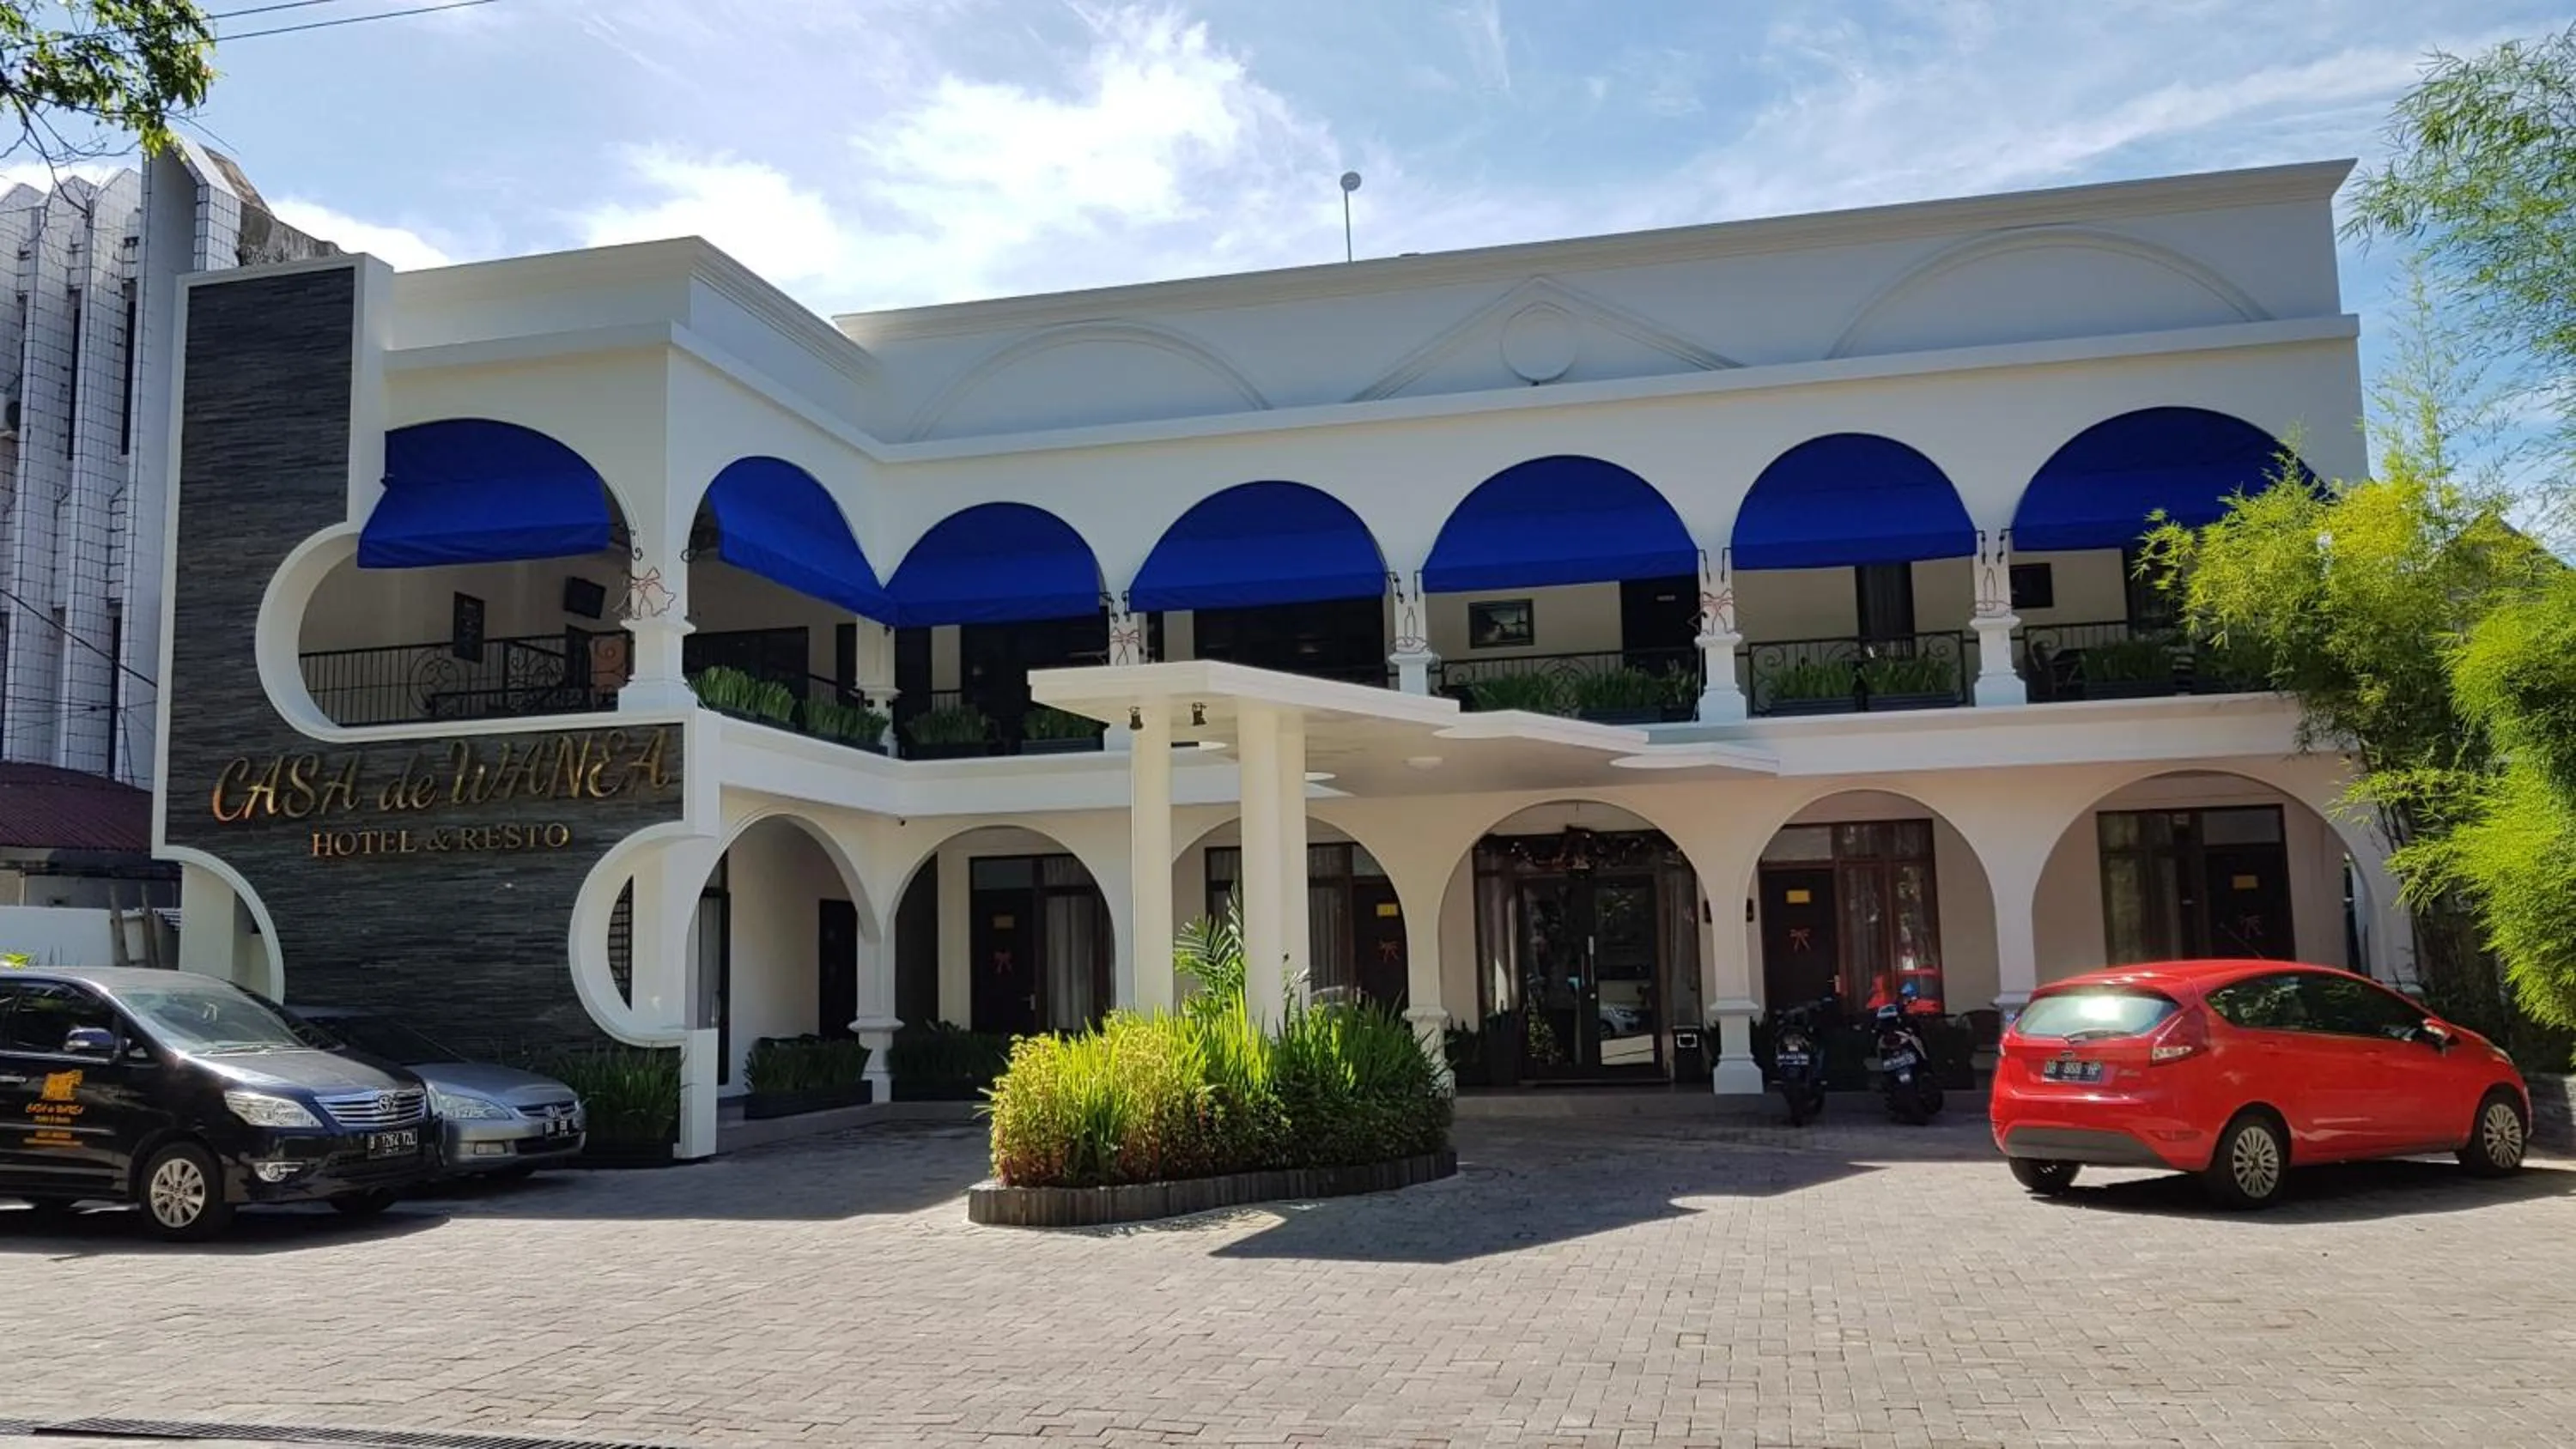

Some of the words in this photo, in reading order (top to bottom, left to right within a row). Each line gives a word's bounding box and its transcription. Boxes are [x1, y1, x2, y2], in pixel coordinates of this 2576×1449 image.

[212, 751, 361, 822] CASA
[378, 753, 438, 811] de
[449, 729, 670, 803] WANEA
[312, 829, 417, 857] HOTEL
[427, 825, 450, 851] &
[459, 822, 569, 852] RESTO
